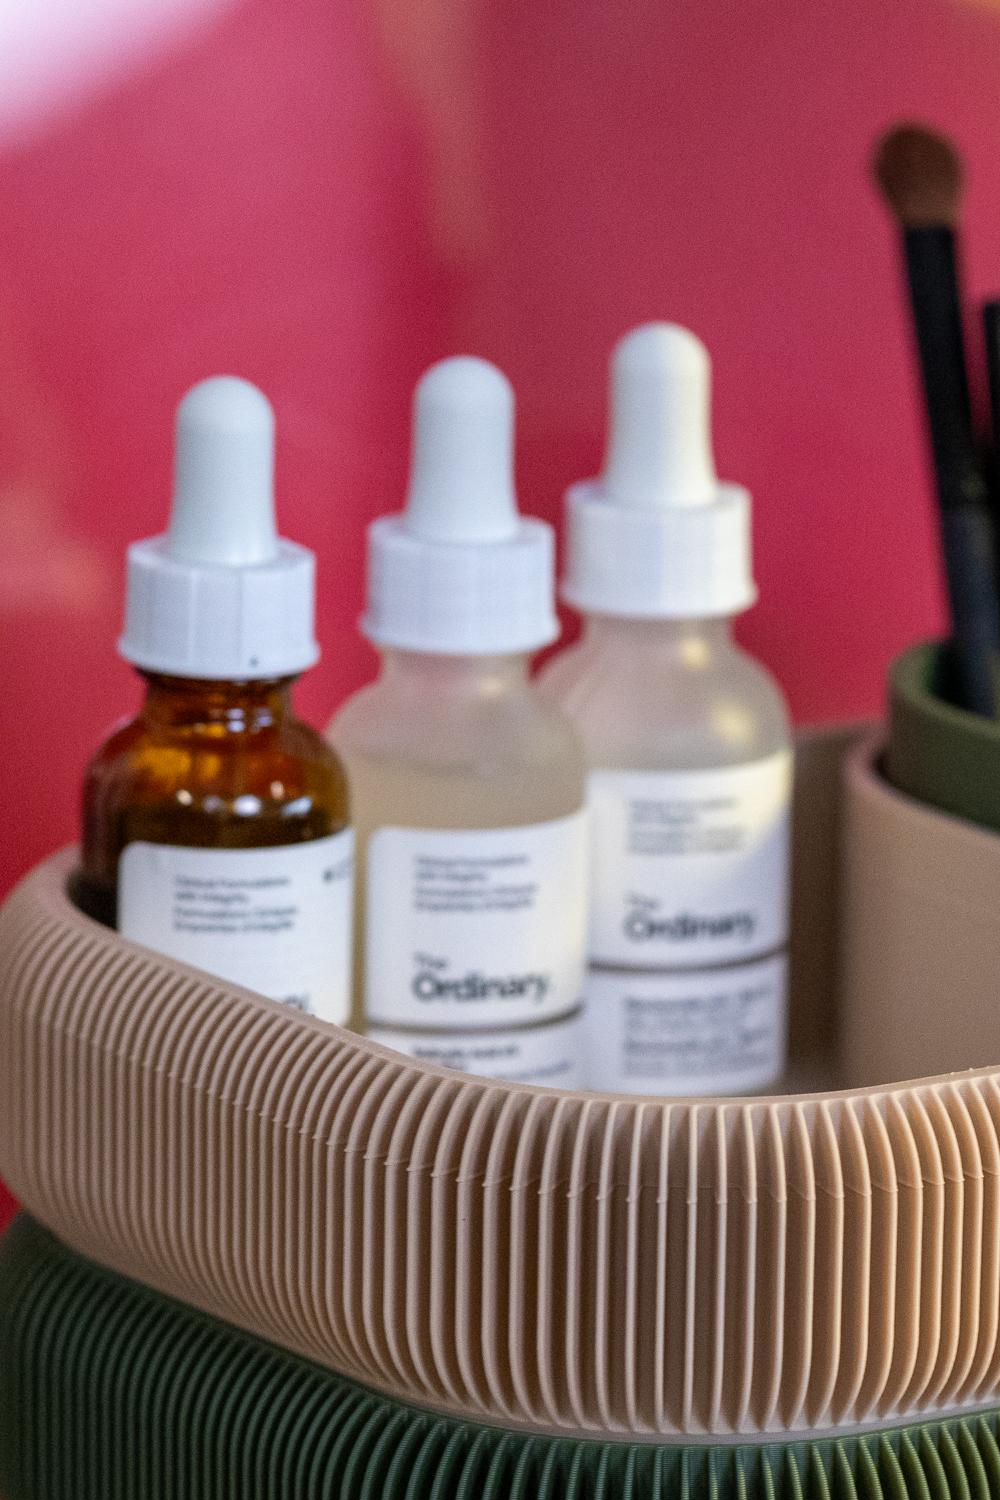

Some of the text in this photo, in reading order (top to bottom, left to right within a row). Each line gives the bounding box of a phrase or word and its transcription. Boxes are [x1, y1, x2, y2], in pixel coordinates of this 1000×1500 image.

[623, 910, 756, 943] Ordinary
[413, 951, 448, 970] The
[411, 971, 550, 1004] Ordinary
